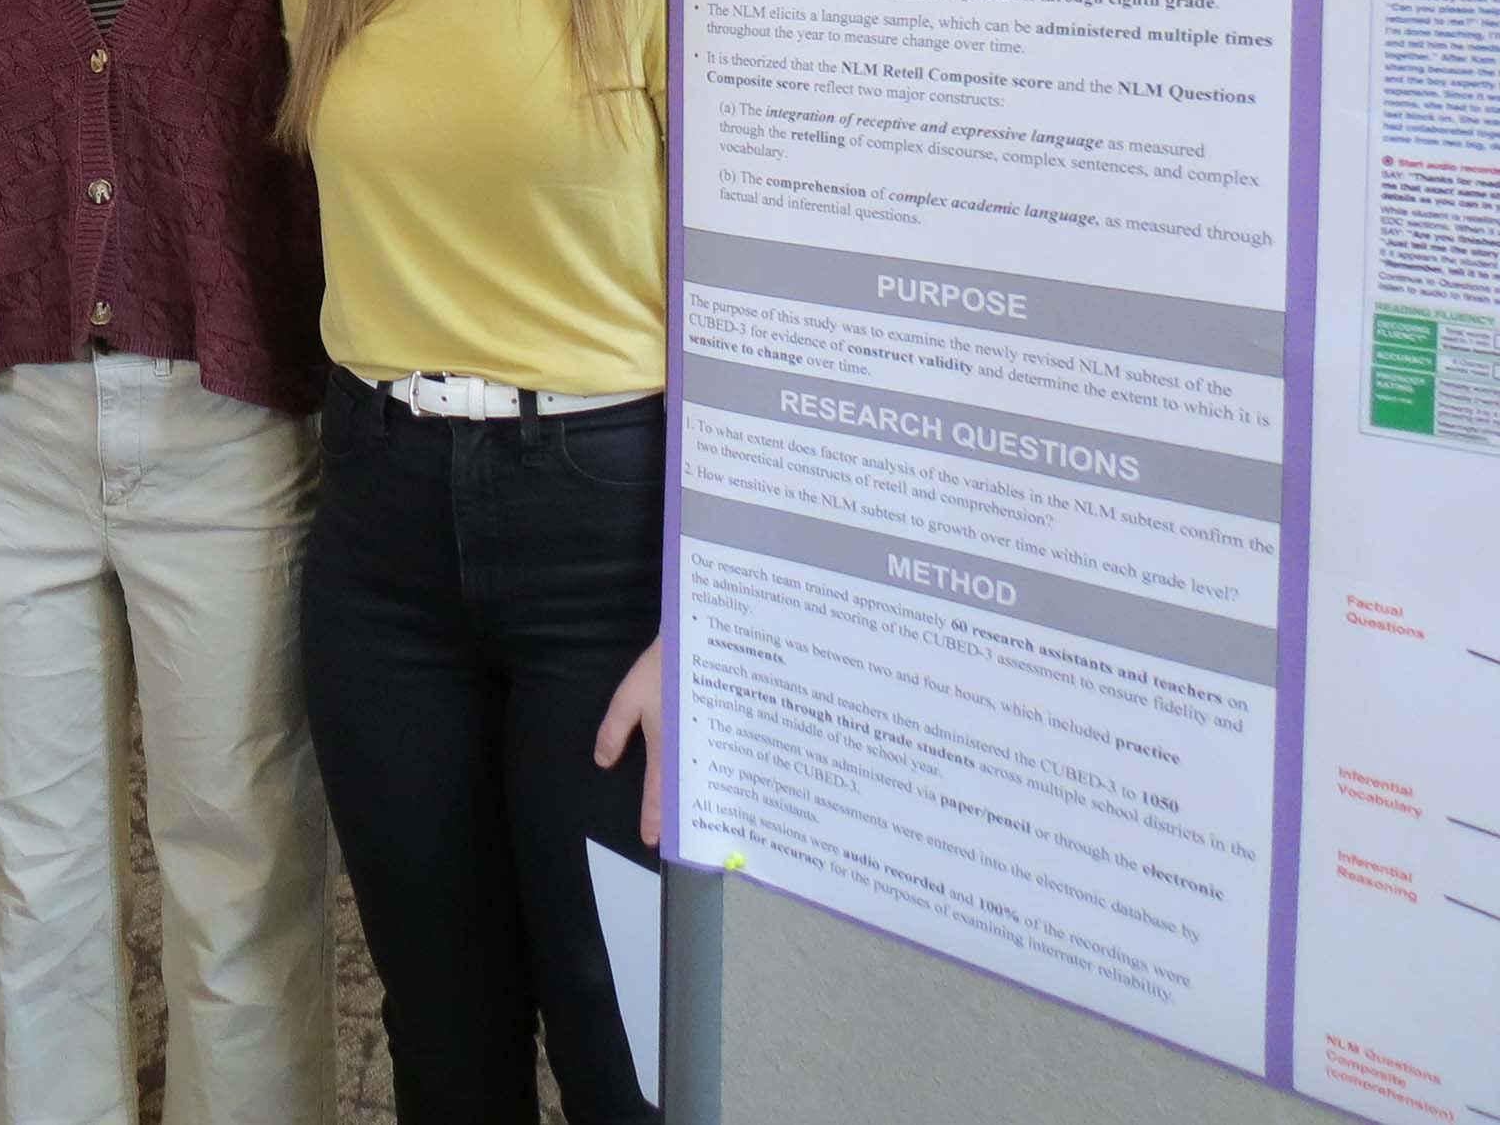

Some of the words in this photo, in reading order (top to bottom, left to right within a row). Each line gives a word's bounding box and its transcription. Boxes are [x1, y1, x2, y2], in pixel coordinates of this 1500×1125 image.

[707, 70, 773, 89] Composite
[776, 80, 810, 91] score
[814, 80, 853, 95] reflect
[858, 86, 882, 97] two
[886, 87, 925, 103] major
[929, 92, 1004, 107] constructs:
[878, 275, 1027, 319] PURPOSE
[689, 335, 738, 352] sensitive
[742, 344, 753, 355] to
[757, 346, 803, 366] change
[807, 357, 834, 369] over
[781, 389, 942, 440] RESEARCH
[952, 422, 1140, 481] QUESTIONS
[697, 466, 724, 482] How
[728, 477, 780, 496] sensitive
[785, 485, 795, 499] is
[798, 488, 817, 504] the
[822, 493, 856, 513] NLM
[861, 505, 906, 523] subtest
[911, 515, 924, 527] to
[928, 521, 976, 539] growth
[981, 532, 1011, 547] over
[1015, 538, 1046, 556] time
[1051, 548, 1097, 569] within
[1102, 562, 1137, 579] each
[1142, 571, 1186, 590] grade
[1191, 578, 1238, 601] level?
[888, 554, 1016, 605] METHOD
[1347, 595, 1403, 616] Factual
[1346, 612, 1425, 640] Questions
[1338, 766, 1413, 797] Inferential
[1337, 783, 1422, 818] Vocabulary
[1338, 850, 1412, 882] Inferential
[1337, 865, 1418, 904] Reasoning
